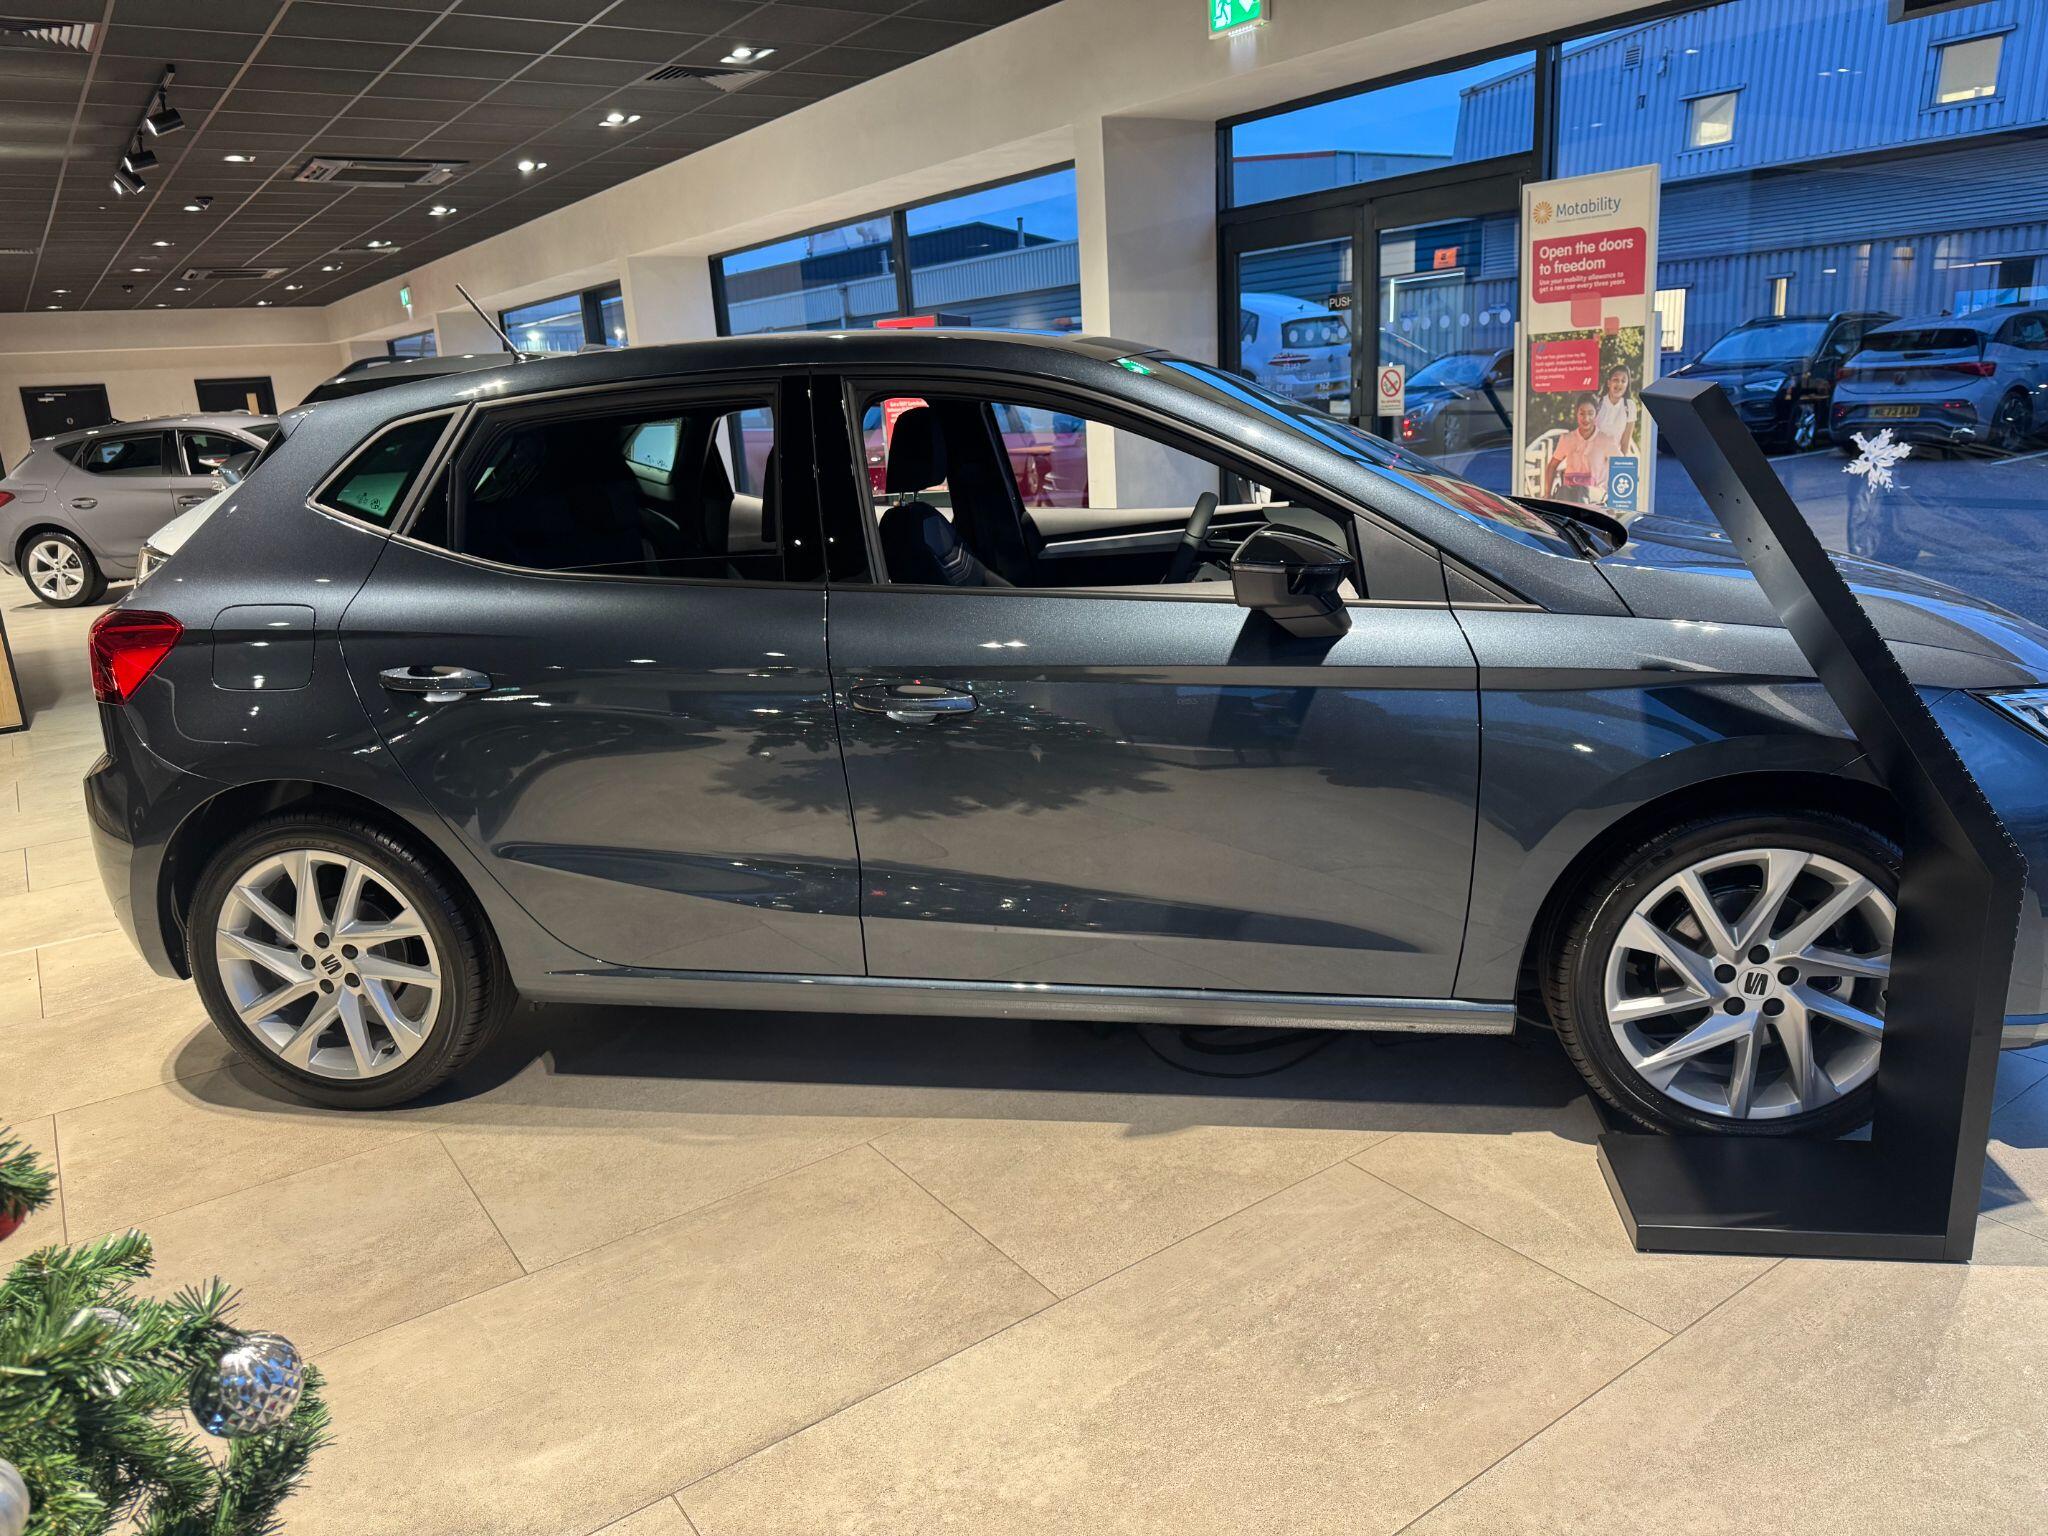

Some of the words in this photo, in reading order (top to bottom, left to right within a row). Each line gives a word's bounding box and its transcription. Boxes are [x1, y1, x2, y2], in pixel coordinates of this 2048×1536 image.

[1556, 197, 1621, 217] Motability
[1539, 246, 1572, 261] Open
[1575, 241, 1596, 254] the
[1598, 238, 1634, 252] doors
[1539, 263, 1552, 275] to
[1554, 257, 1606, 273] freedom
[1539, 286, 1548, 294] get
[1576, 282, 1593, 290] every
[1610, 279, 1626, 287] years
[1551, 278, 1562, 286] your
[1563, 275, 1587, 283] mobility
[1588, 273, 1616, 281] allowance
